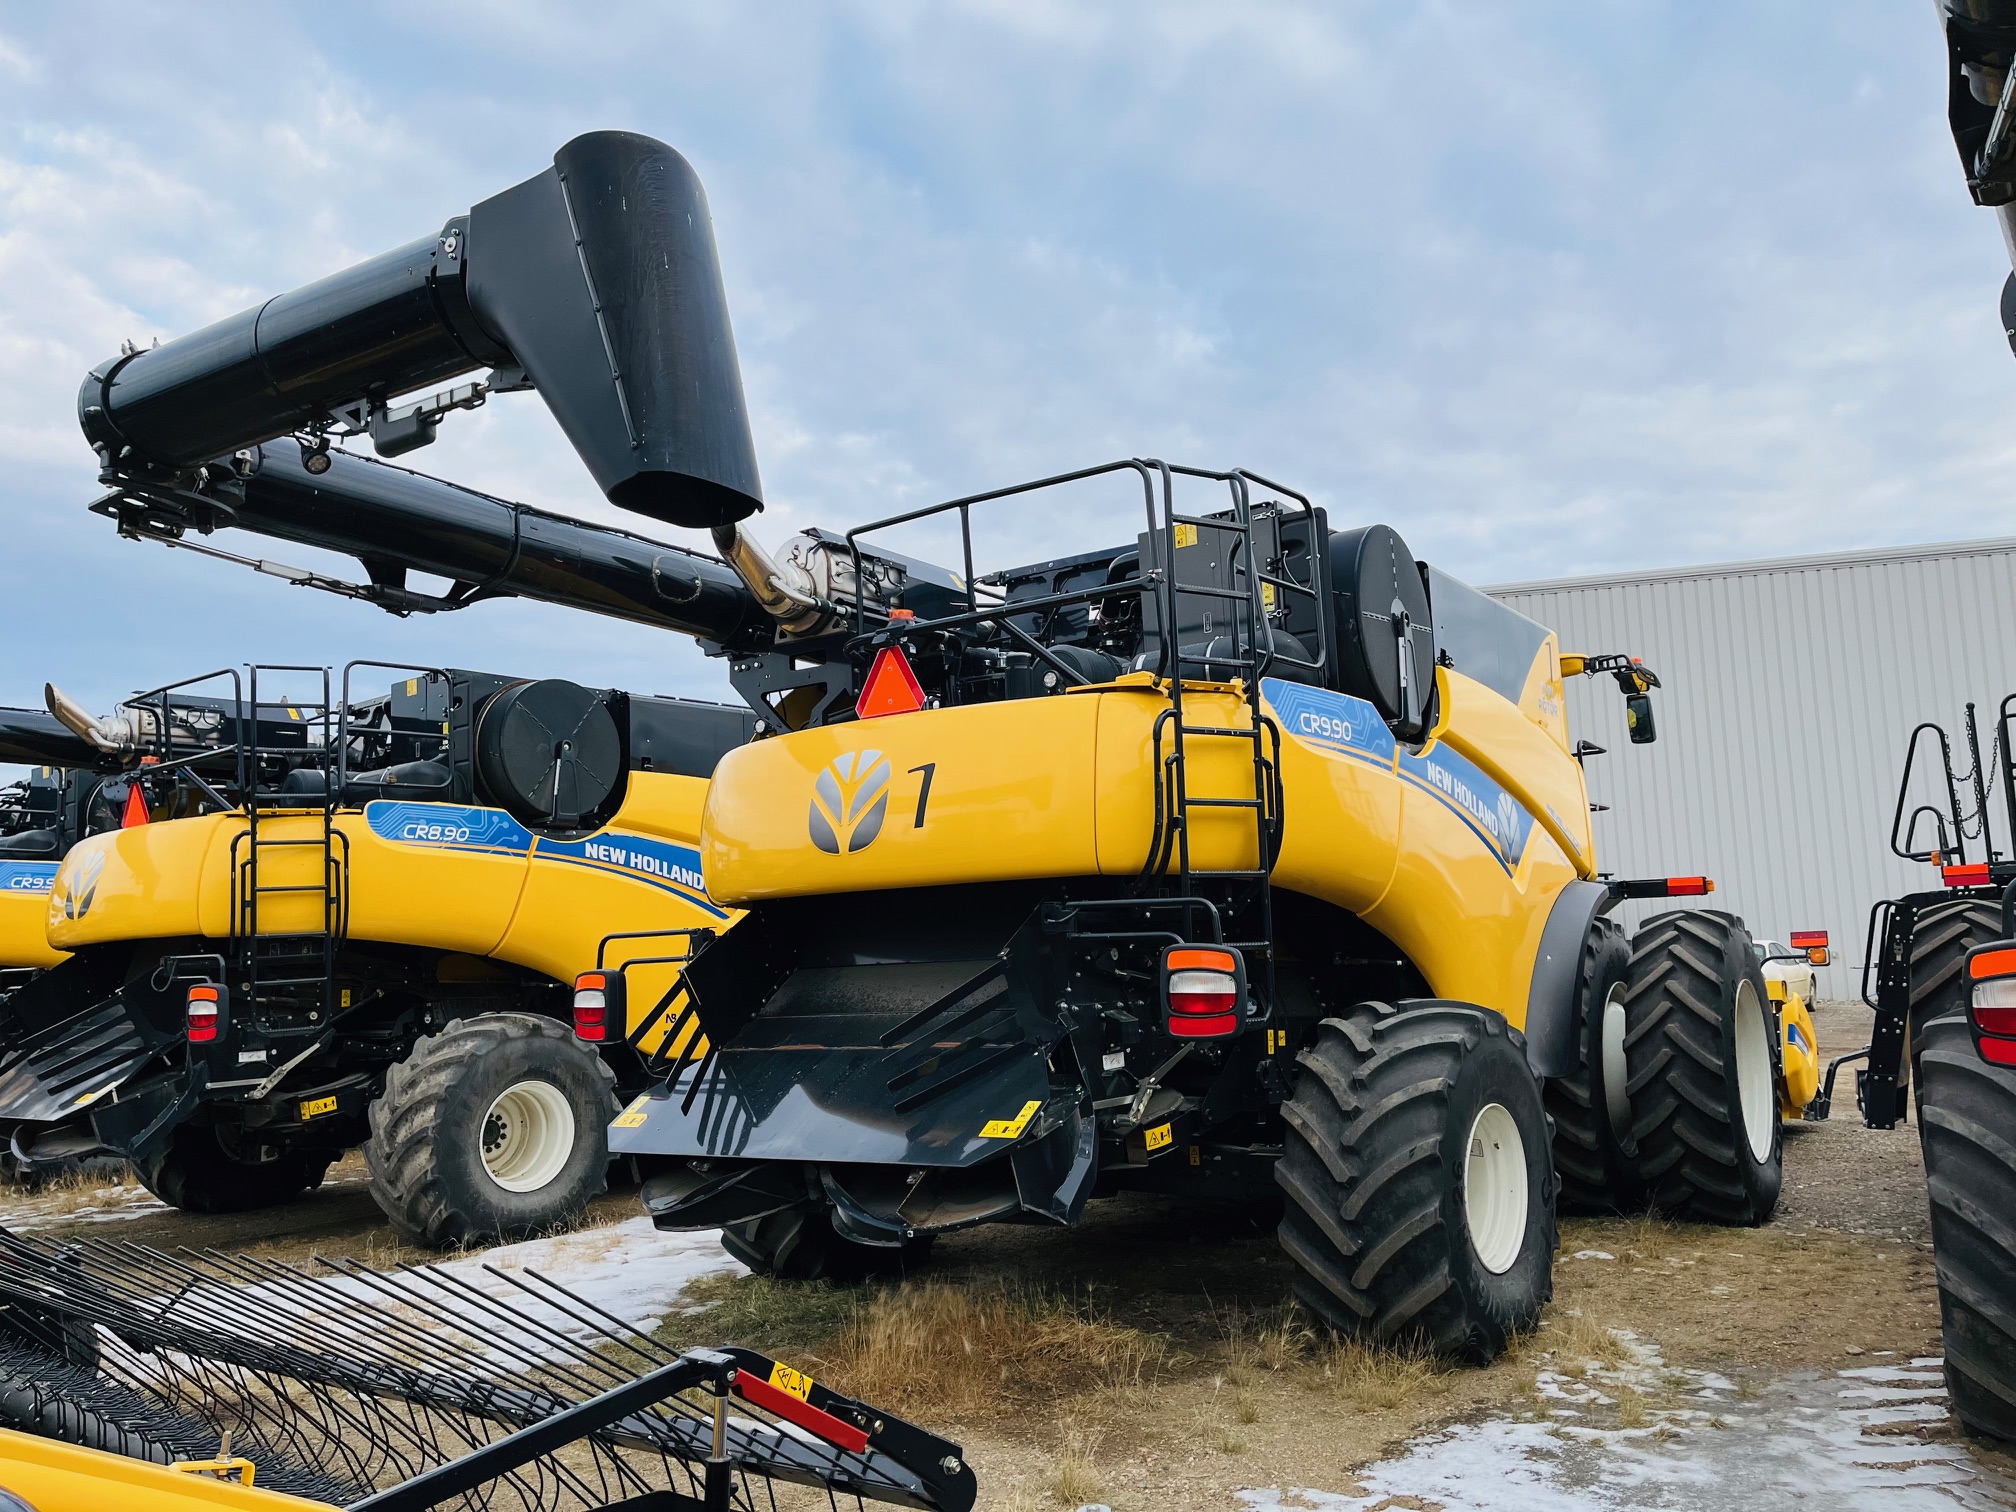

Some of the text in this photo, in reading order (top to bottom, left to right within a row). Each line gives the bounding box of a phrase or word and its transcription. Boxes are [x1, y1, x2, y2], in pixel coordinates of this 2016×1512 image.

[1300, 712, 1352, 742] CR9.90
[907, 762, 936, 829] 1
[1426, 759, 1452, 795] NEW
[1453, 777, 1499, 837] HOLLAND
[403, 823, 470, 842] CR8.90
[584, 841, 705, 890] NEW HOLLAND
